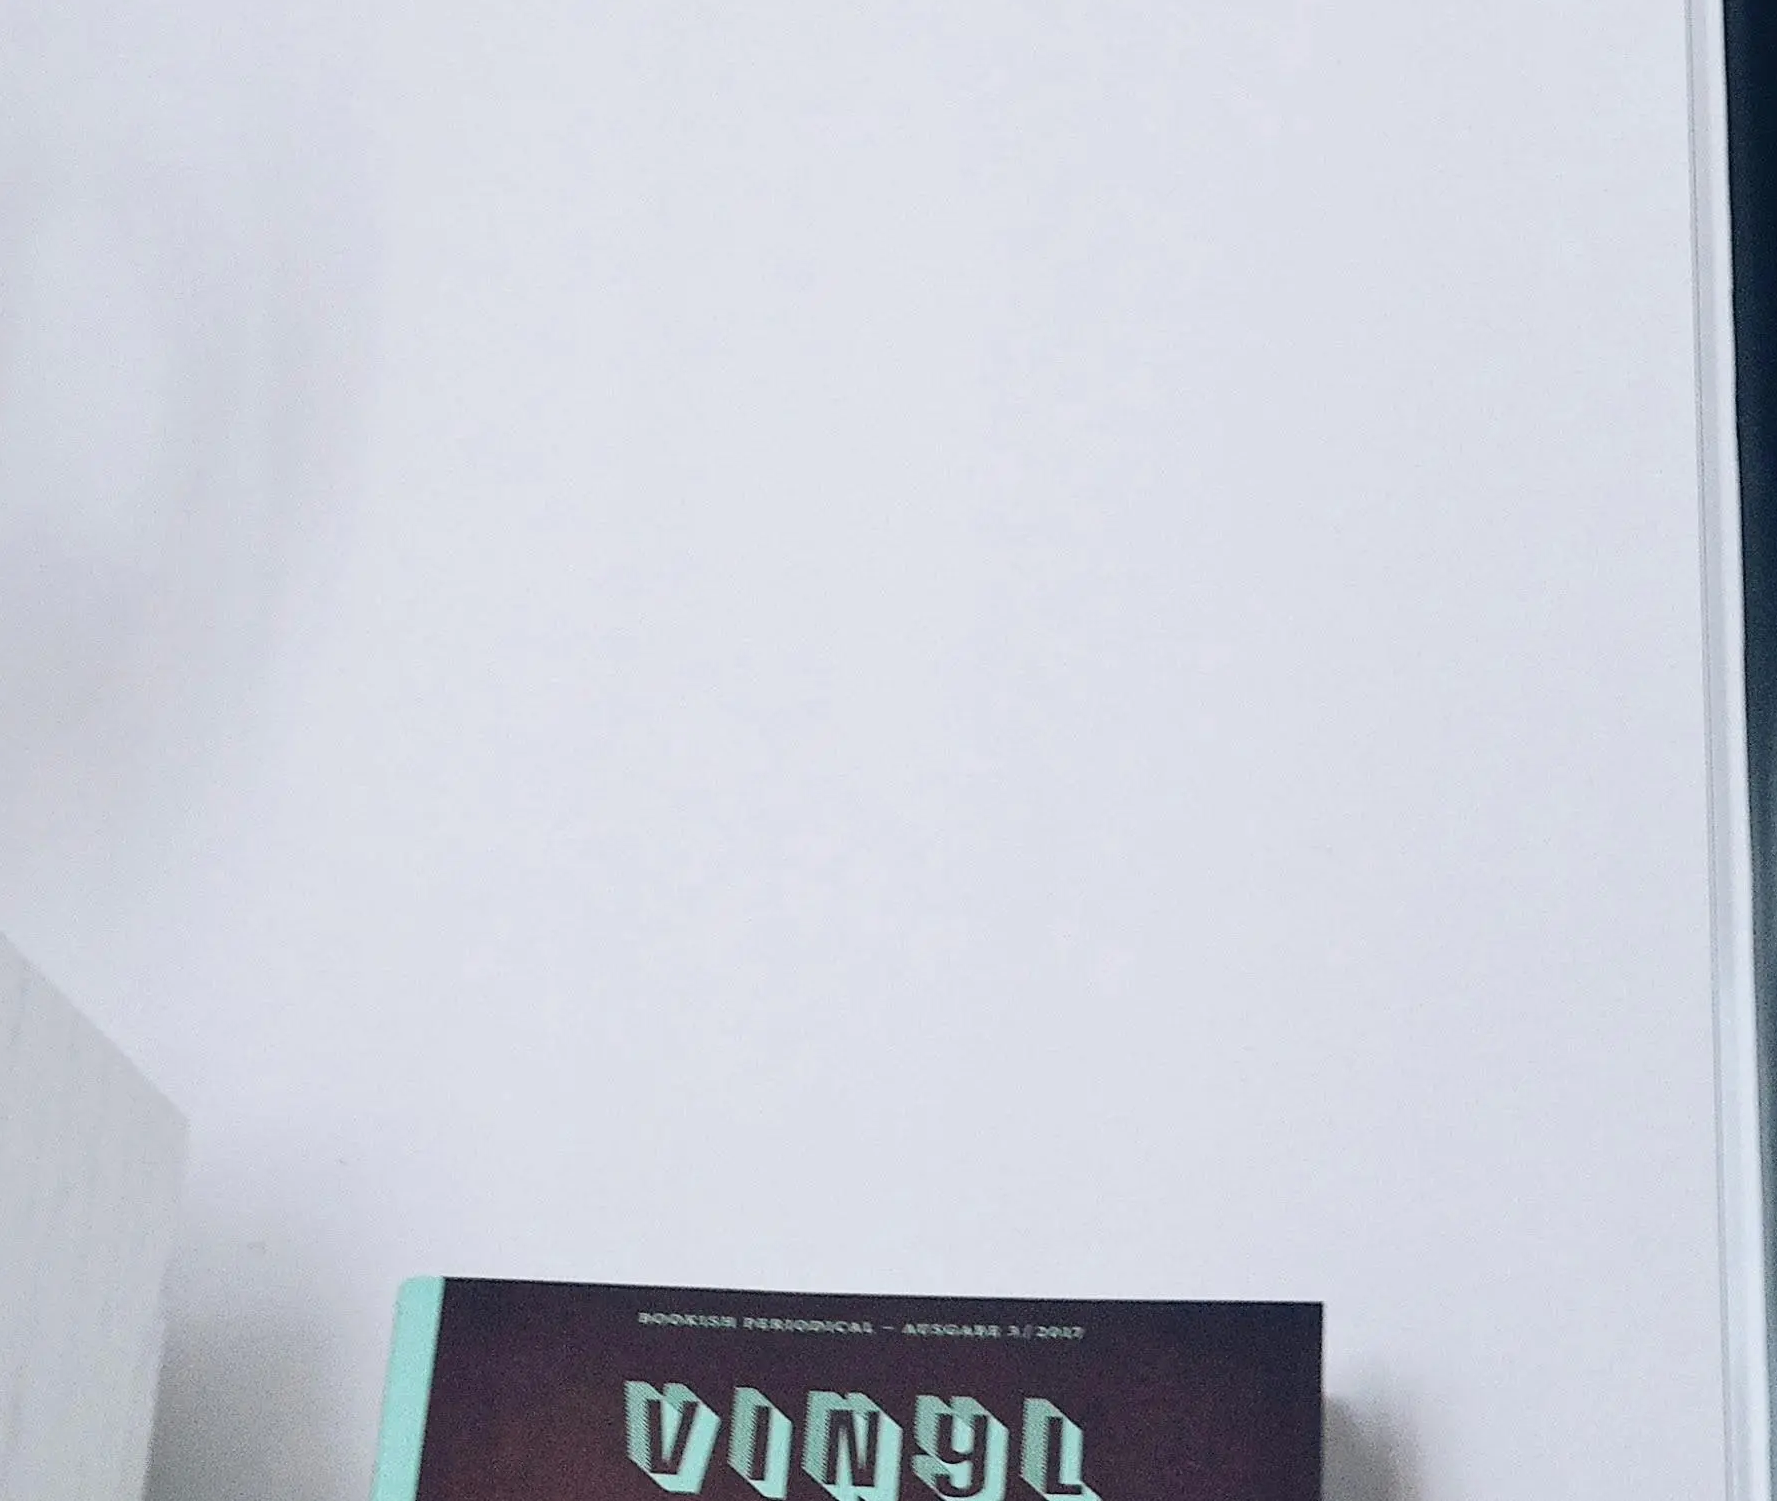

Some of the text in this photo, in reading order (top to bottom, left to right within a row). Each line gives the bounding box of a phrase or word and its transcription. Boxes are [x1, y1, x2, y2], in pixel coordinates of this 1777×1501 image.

[637, 1311, 737, 1329] BOOKISH
[742, 1316, 876, 1335] PERIODICAL
[623, 1379, 1105, 1501] VINYL
